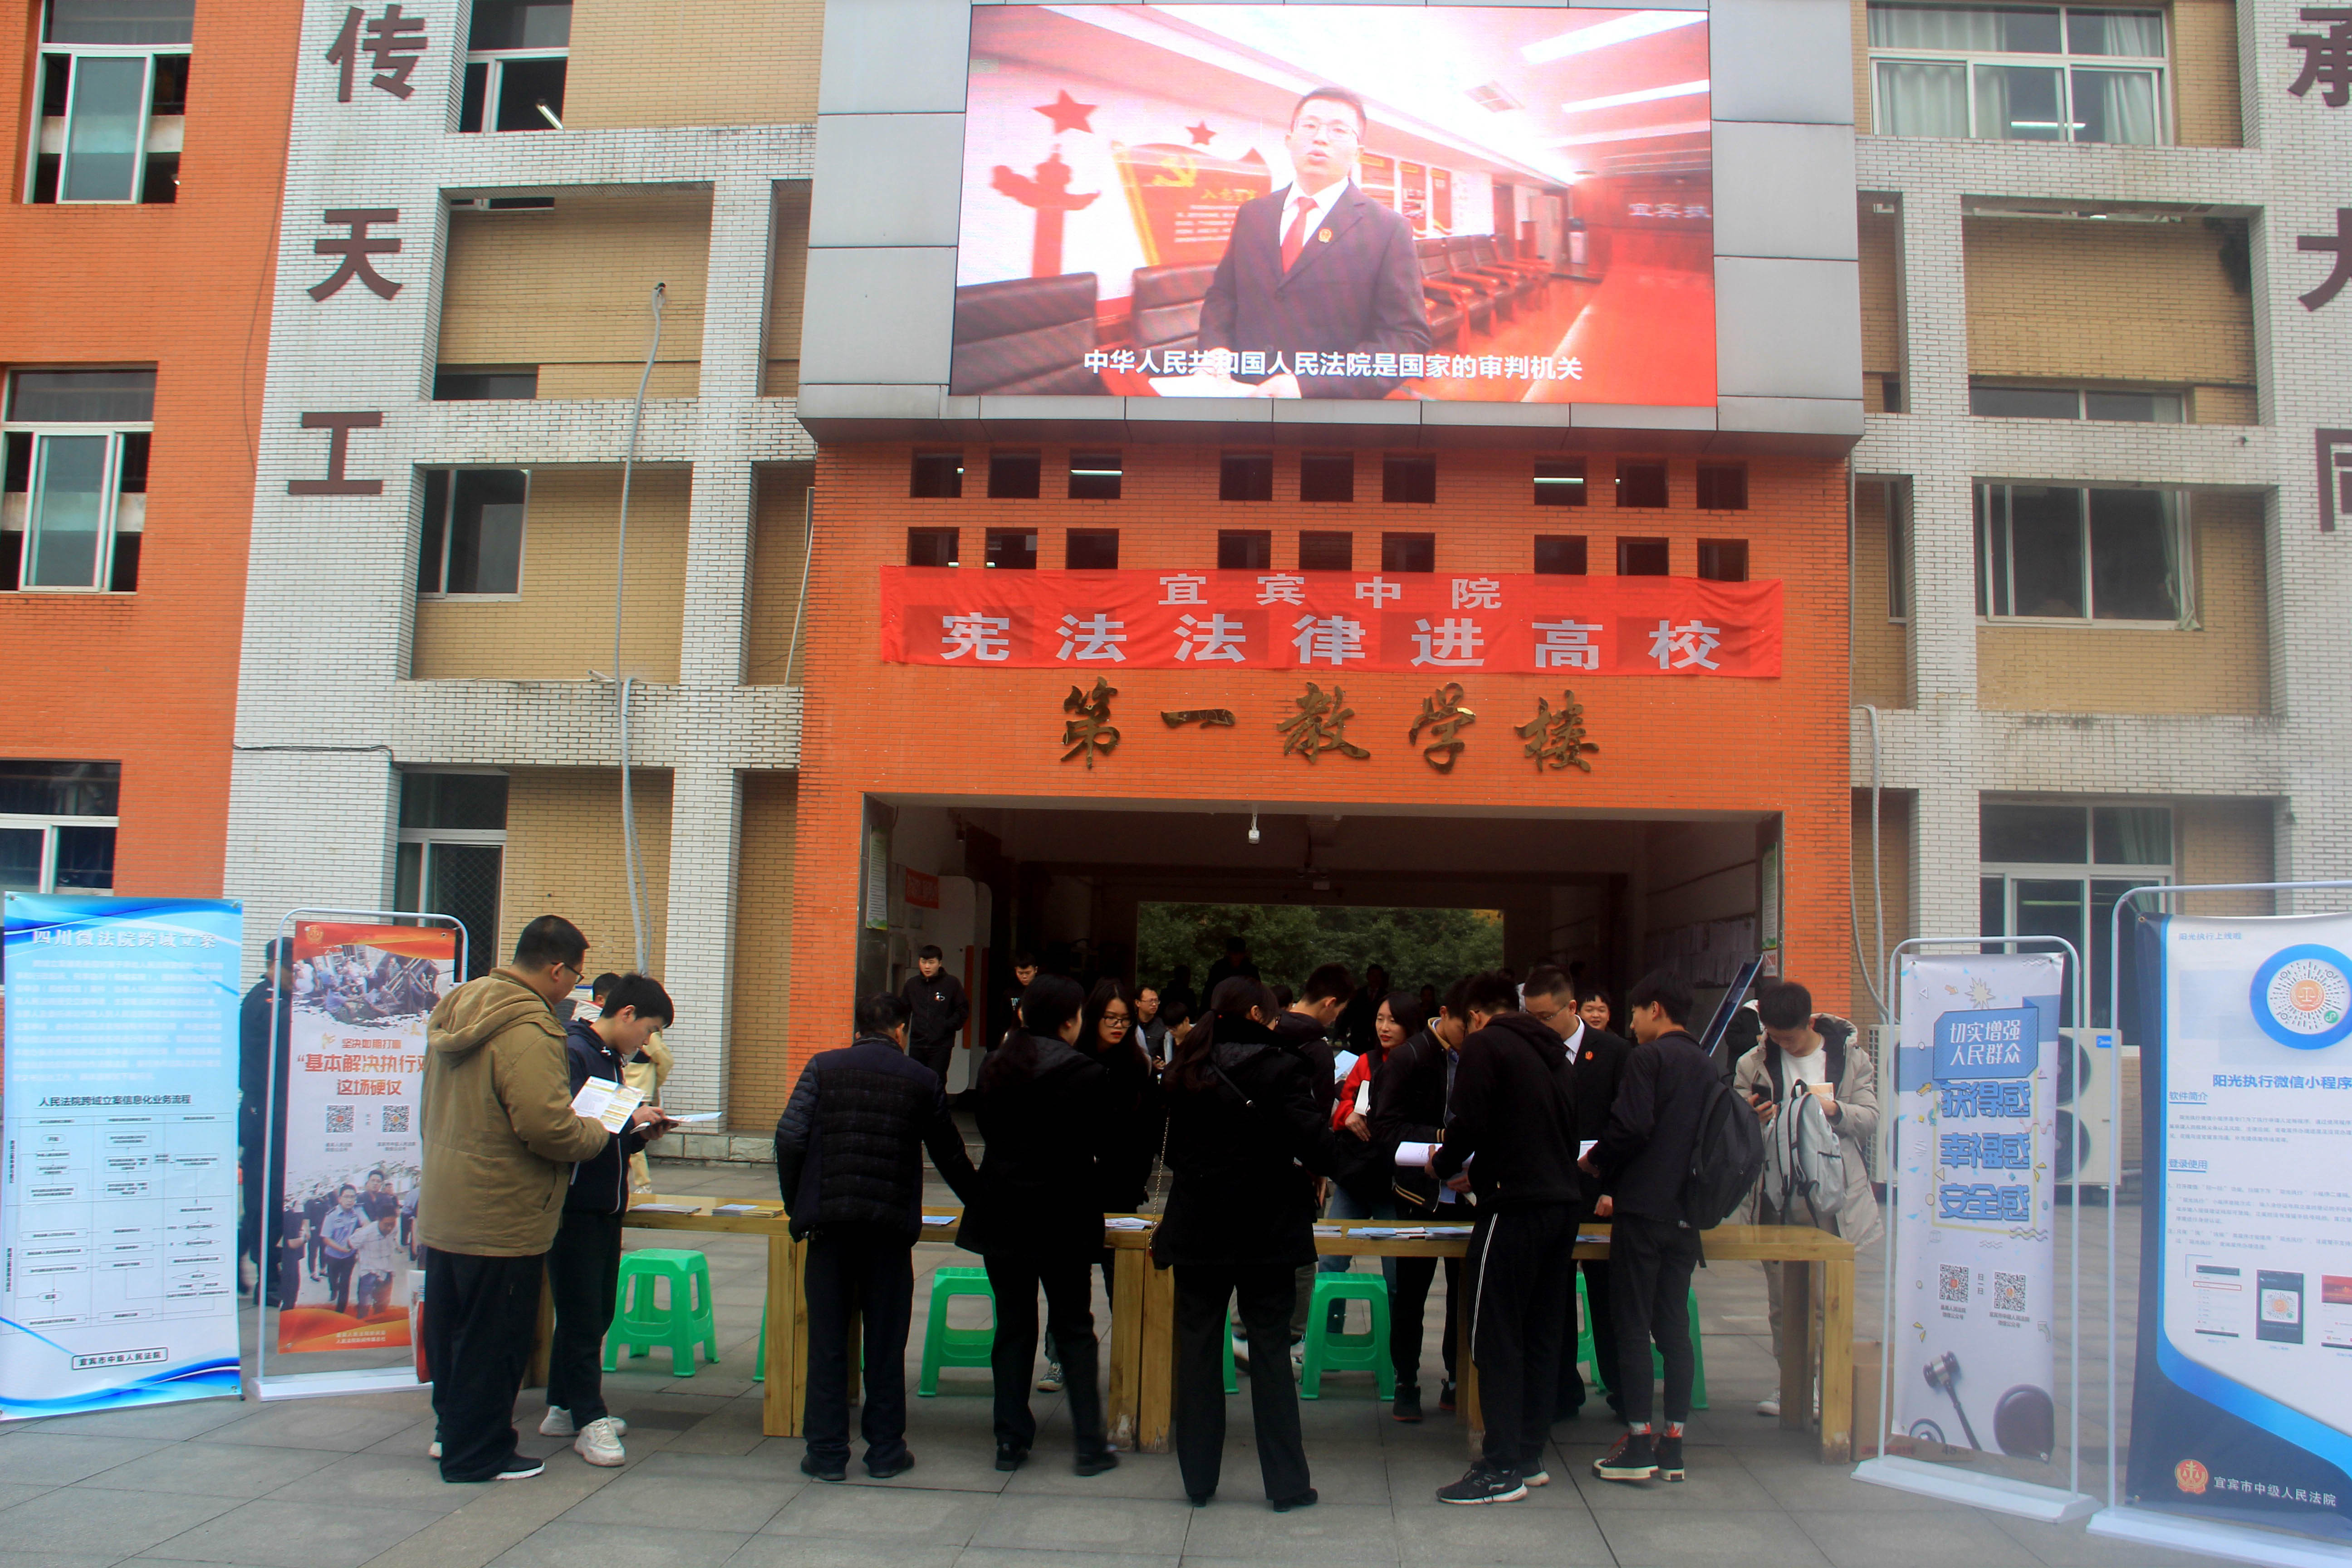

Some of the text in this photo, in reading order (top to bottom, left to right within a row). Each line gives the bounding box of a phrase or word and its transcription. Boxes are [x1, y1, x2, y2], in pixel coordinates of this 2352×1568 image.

[1083, 349, 1583, 382] 中华人民共和国人民法院是国家的审判机关
[1156, 573, 1502, 611] 宜宾中院
[940, 612, 1722, 672] 宪法法律进高校
[1060, 676, 1600, 775] 第一教学楼
[32, 929, 217, 949] 四川微法院跨域立案
[1950, 1019, 2022, 1043] 切实增强
[1950, 1043, 2022, 1066] 人民群众
[337, 1079, 402, 1095] 这场硬仗
[2212, 1073, 2352, 1090] 阳光执行微信小程序
[39, 1094, 191, 1107] 人民法院跨域立案信息化业务流程
[1940, 1080, 2031, 1118] 获得感
[2169, 1092, 2208, 1102] 软件简介
[1939, 1132, 2031, 1170] 幸福感
[2168, 1159, 2208, 1170] 登录使用
[1939, 1183, 2031, 1222] 安全感
[79, 1351, 162, 1366] 宜宾市中级人民法院
[2214, 1475, 2337, 1507] 宜宾市中级人民法院
